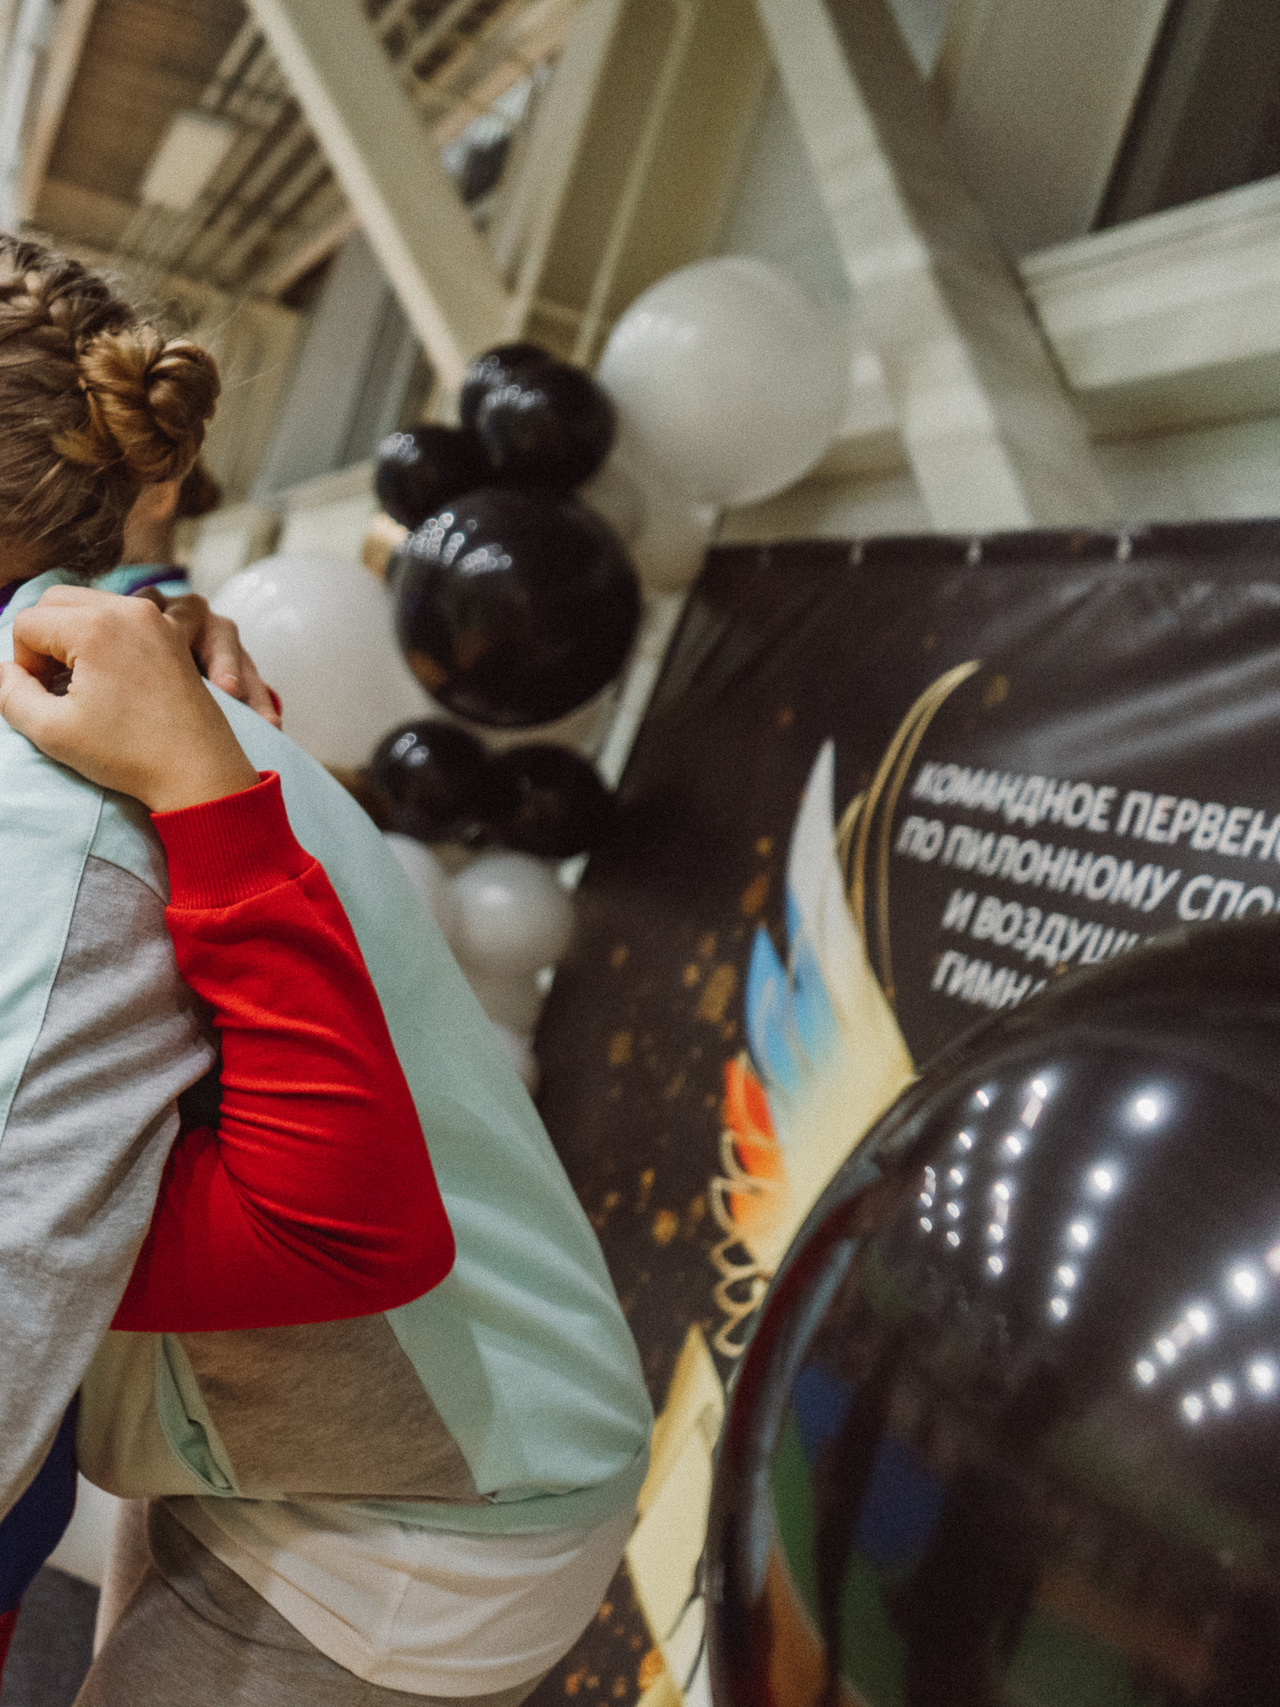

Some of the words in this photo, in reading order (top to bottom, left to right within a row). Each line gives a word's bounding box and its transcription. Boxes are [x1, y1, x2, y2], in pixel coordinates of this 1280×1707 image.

[912, 762, 1119, 833] КОМАНДНОЕ
[1116, 790, 1280, 863] ПЕРВЕН
[896, 815, 946, 862] ПО
[941, 824, 1182, 914] ПИЛОННОМУ
[1177, 874, 1280, 922] СПО
[941, 888, 977, 933] И
[971, 895, 1155, 968] ВОЗДУШ
[930, 950, 1048, 1011] ГИМН
